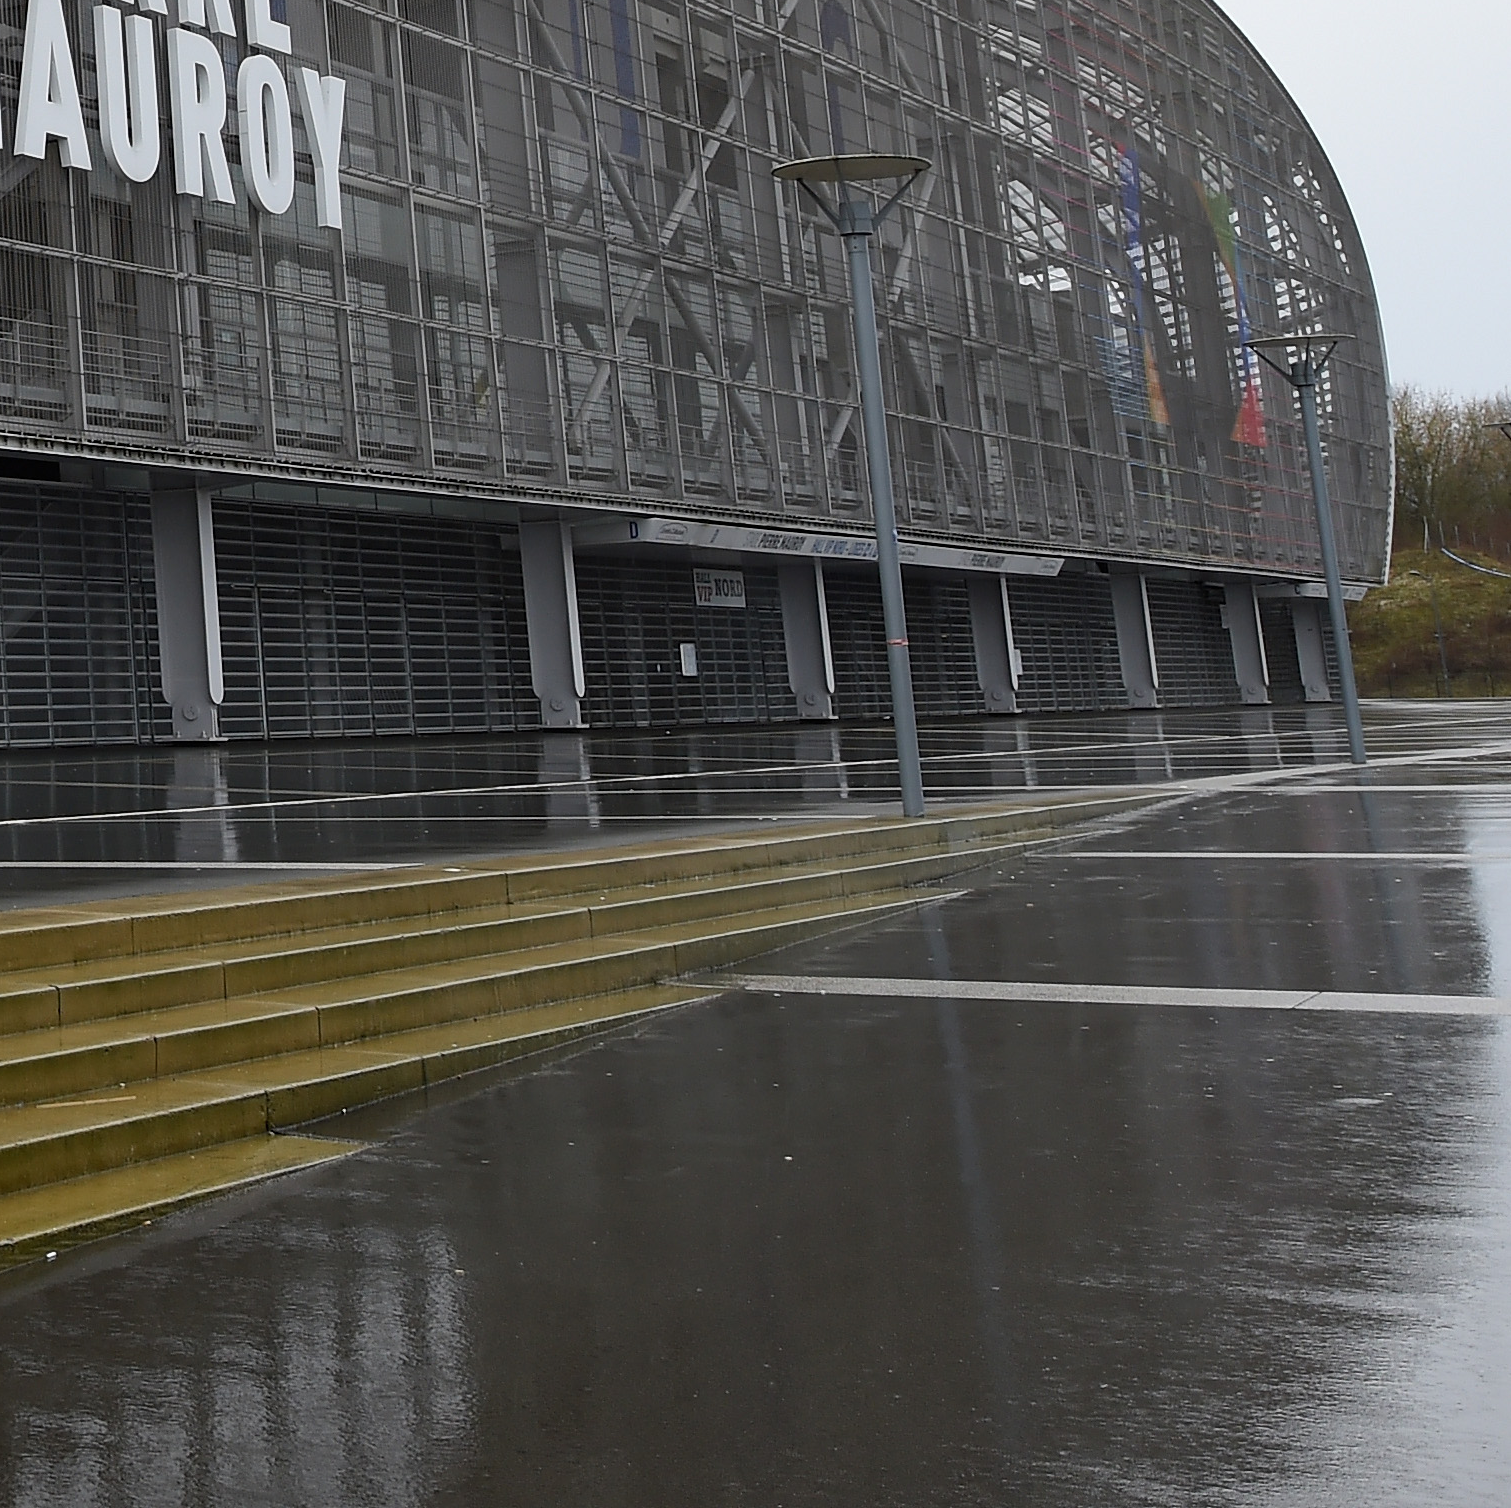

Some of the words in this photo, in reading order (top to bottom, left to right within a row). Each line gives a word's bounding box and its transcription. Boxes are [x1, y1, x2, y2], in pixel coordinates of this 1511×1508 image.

[629, 521, 638, 539] D
[697, 585, 713, 602] VIP
[714, 578, 743, 597] NORD
